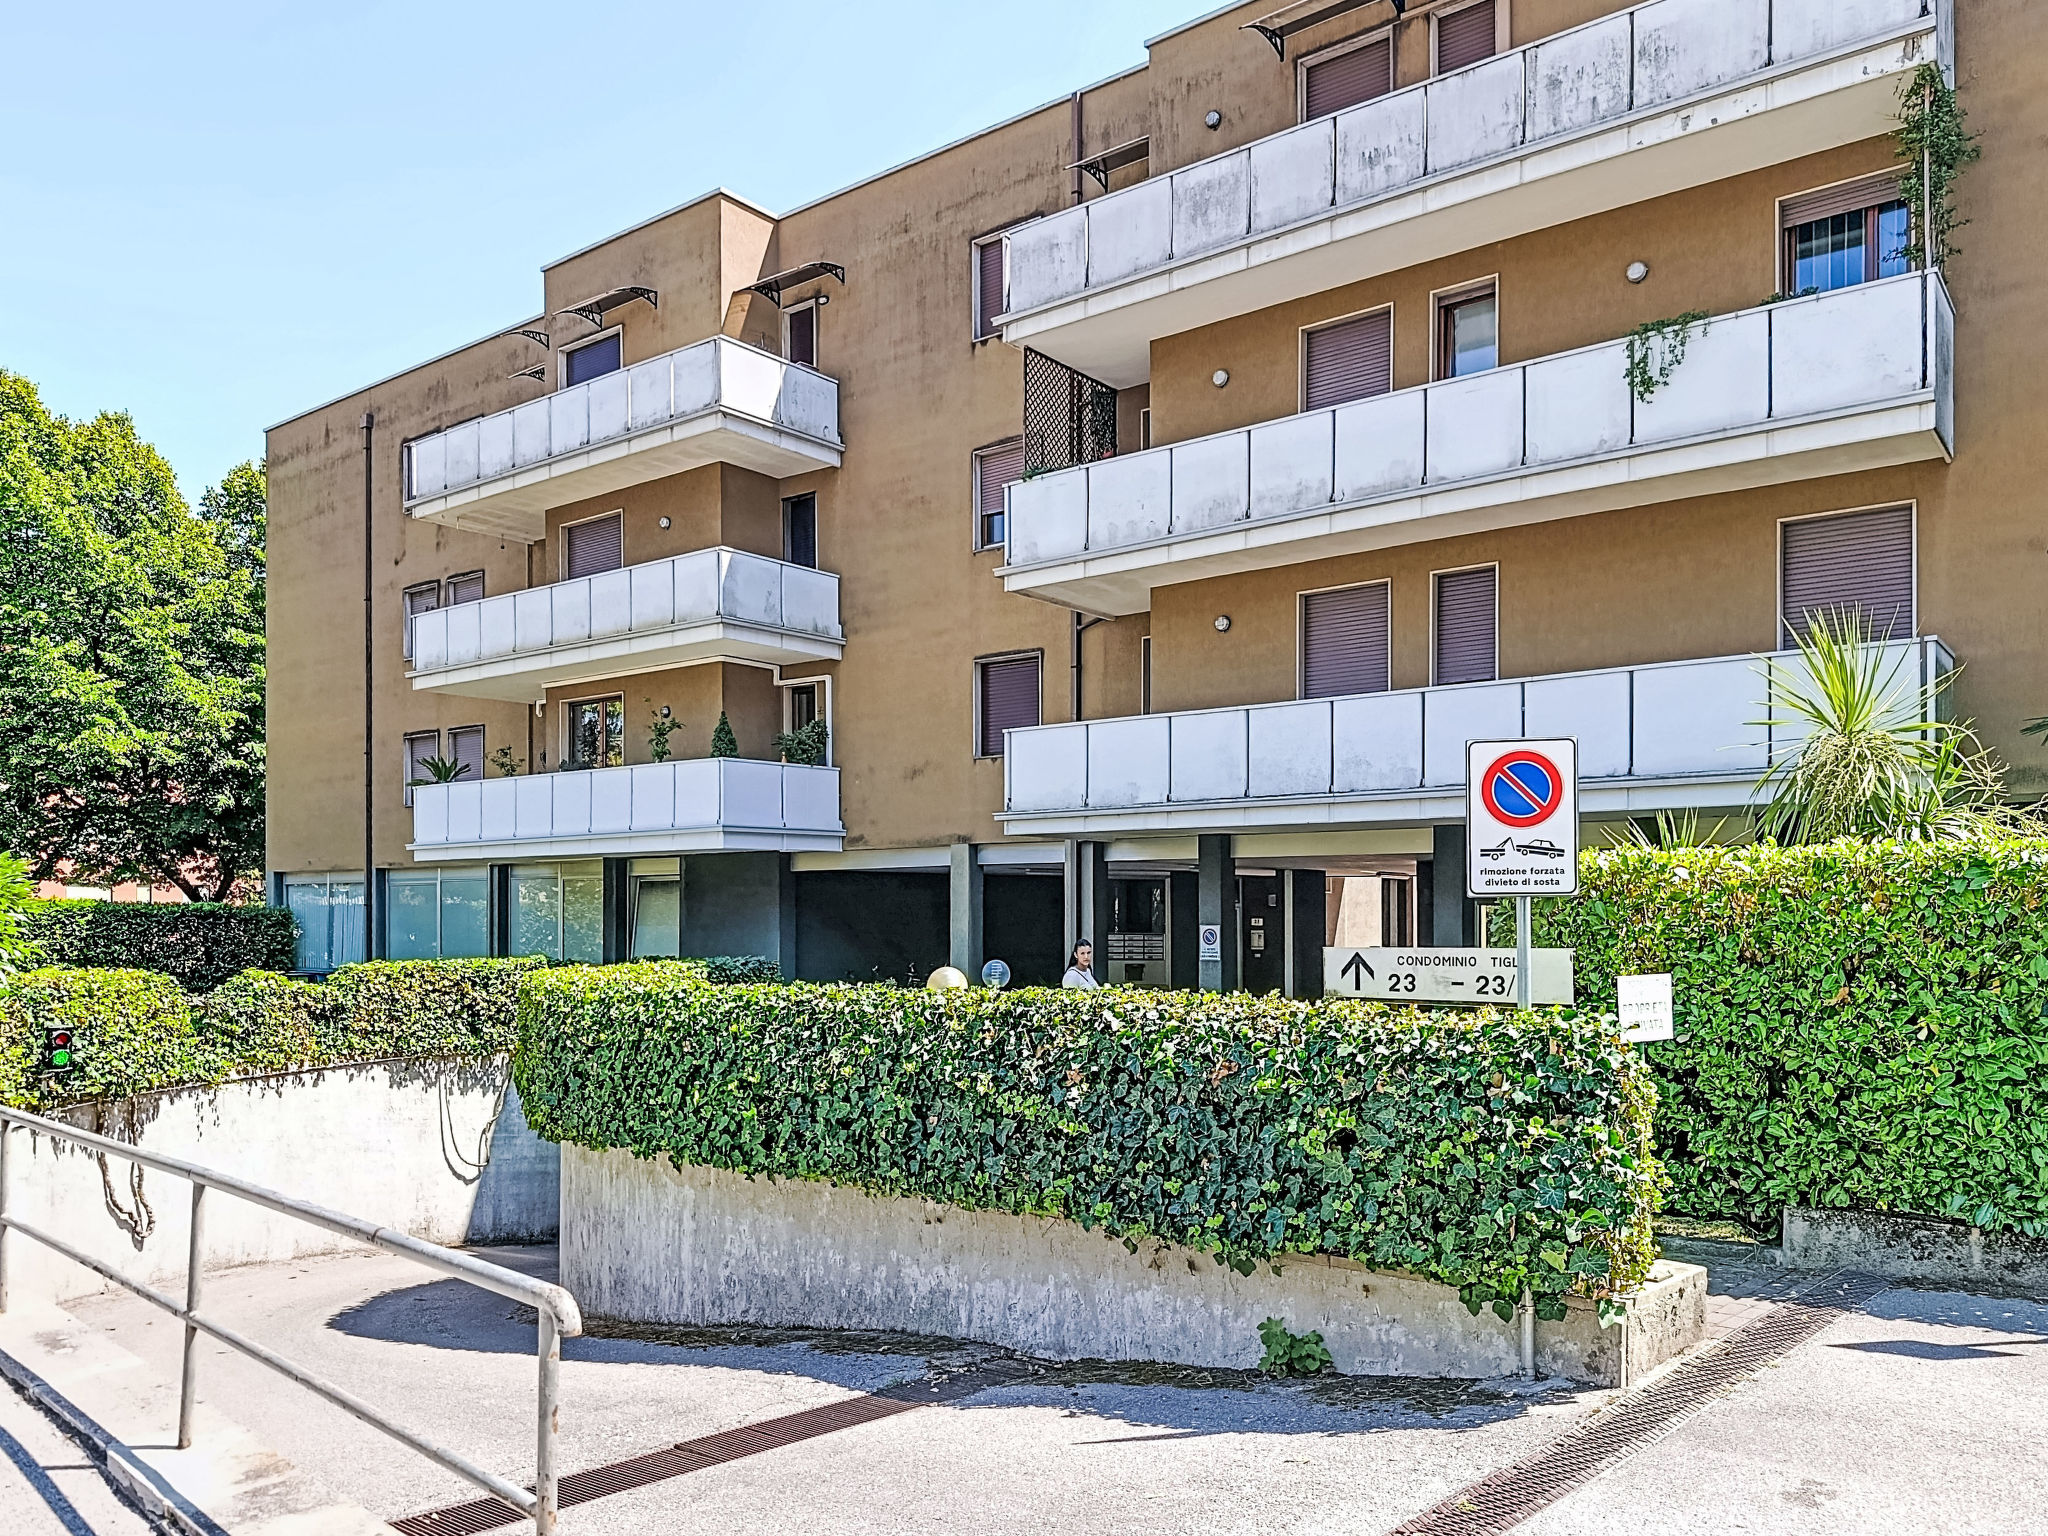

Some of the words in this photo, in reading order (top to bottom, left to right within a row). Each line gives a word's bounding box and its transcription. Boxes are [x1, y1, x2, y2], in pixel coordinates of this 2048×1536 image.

[1480, 867, 1527, 875] rimozione
[1530, 867, 1565, 875] forzata
[1485, 878, 1519, 886] divieto
[1521, 878, 1531, 886] di
[1533, 878, 1560, 886] sosta
[1397, 955, 1477, 967] CONDOMINIO
[1490, 956, 1518, 968] TIGL
[1388, 973, 1416, 993] 23
[1475, 974, 1516, 997] 23/
[1622, 1001, 1668, 1015] PROPRETA
